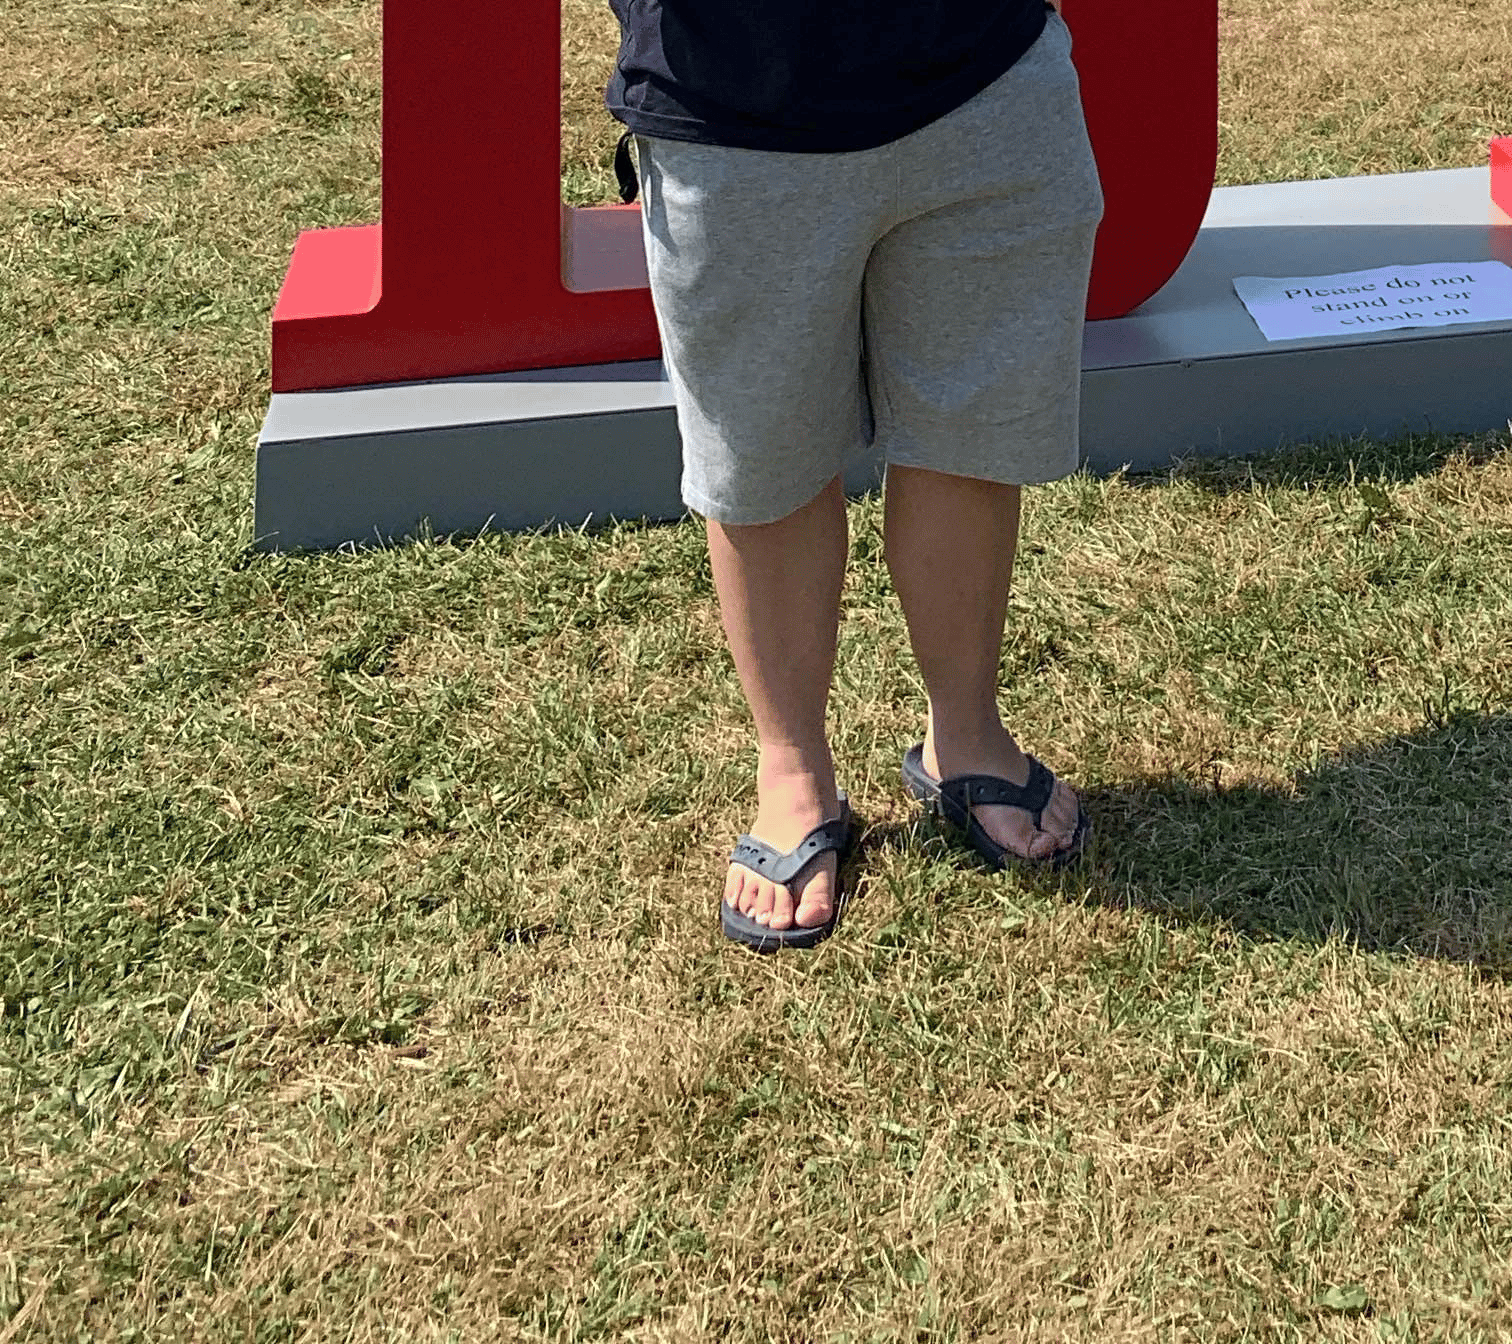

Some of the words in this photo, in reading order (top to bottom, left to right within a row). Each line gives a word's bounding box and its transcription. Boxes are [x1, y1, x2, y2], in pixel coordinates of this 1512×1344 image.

[1284, 283, 1377, 300] Please
[1386, 277, 1421, 290] do
[1431, 274, 1477, 286] not
[1311, 296, 1388, 313] stand
[1397, 293, 1434, 305] on
[1443, 290, 1472, 300] or
[1340, 311, 1424, 326] climb
[1433, 306, 1470, 317] on
